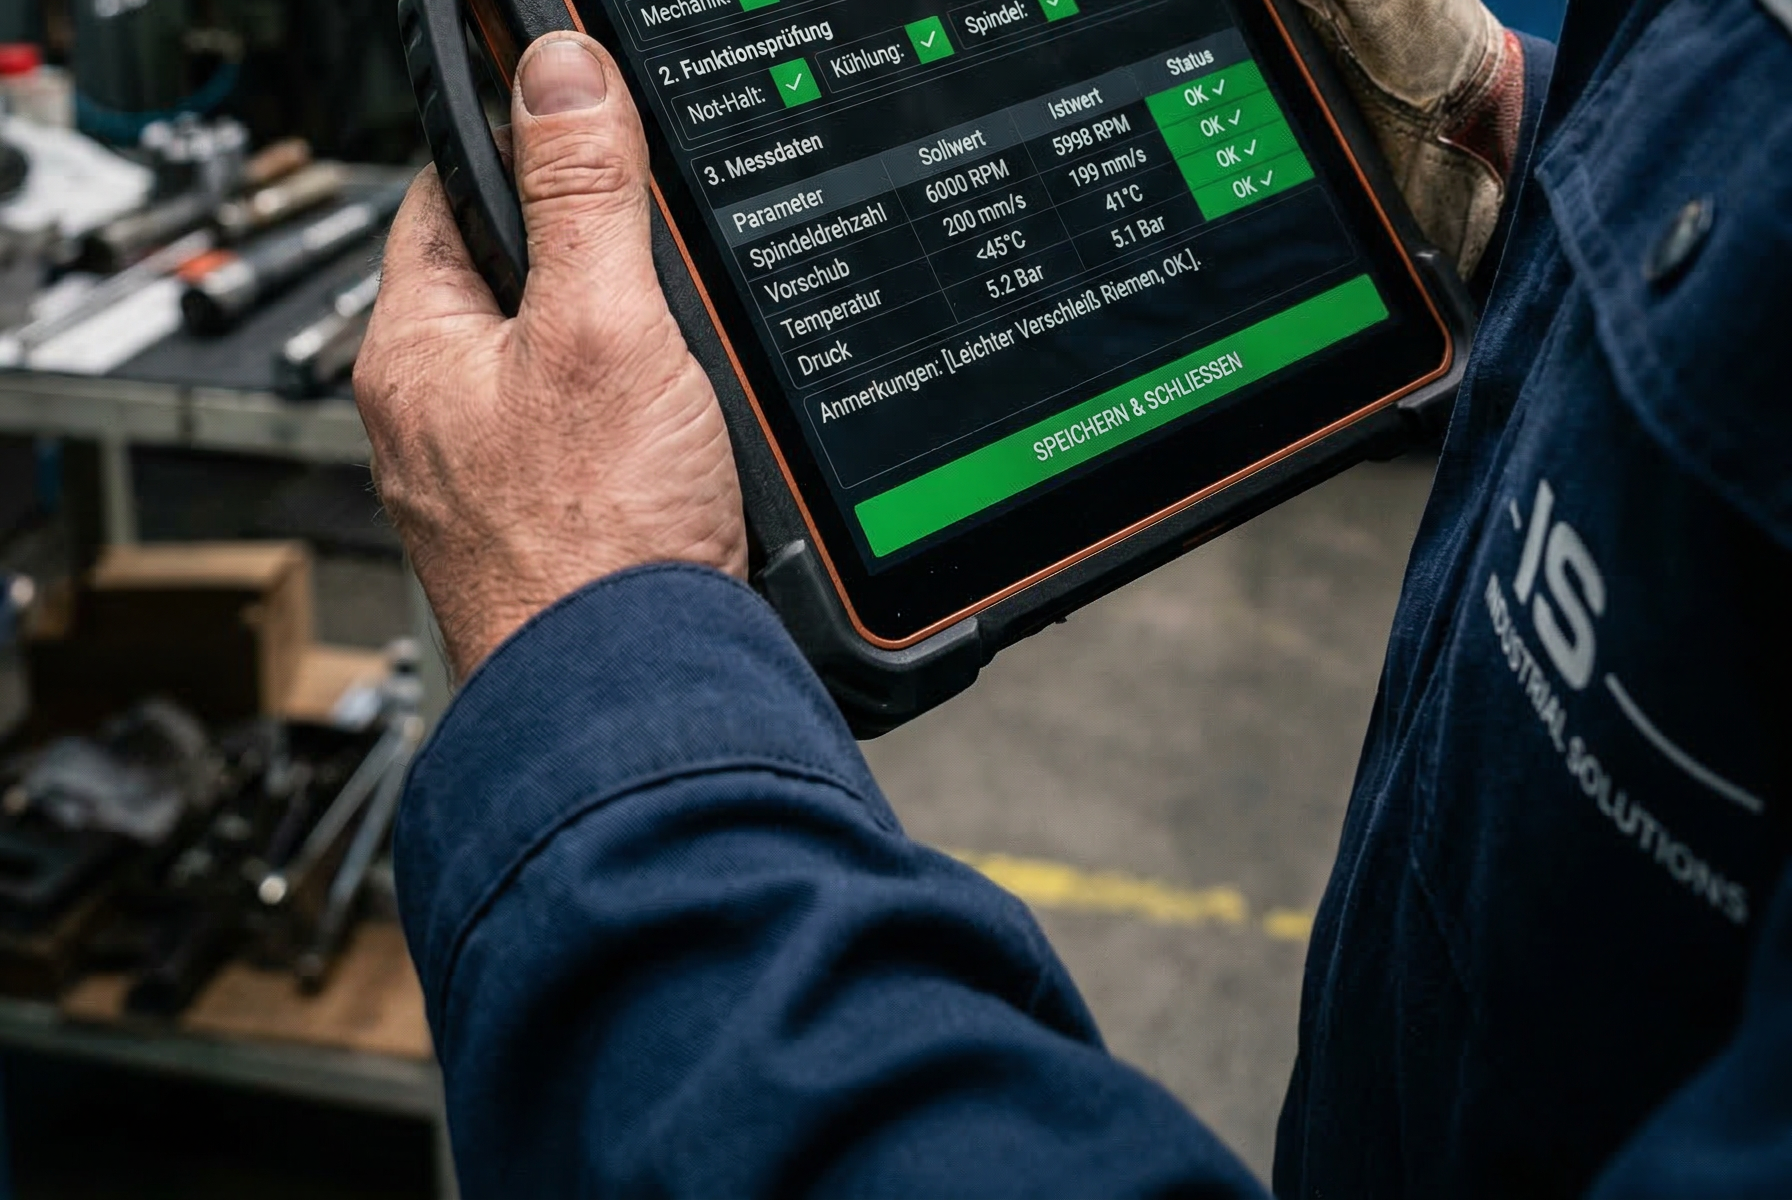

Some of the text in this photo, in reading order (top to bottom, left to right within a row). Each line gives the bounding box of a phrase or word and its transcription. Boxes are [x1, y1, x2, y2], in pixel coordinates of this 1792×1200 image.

[658, 20, 834, 86] 2. Funktionsprüfung
[830, 43, 905, 78] Kühlung:
[965, 1, 1028, 36] Spindel:
[687, 85, 766, 125] Not-Halt:
[703, 134, 823, 186] 3. Messdaten
[732, 49, 1215, 233] Parameter Sollwert Istwert Status
[749, 86, 1210, 270] Spindeldrehzahl 6000 RPM 5998 RPM OK
[764, 116, 1225, 303] Vorschub 200 mm/s 199 mm/s OK
[780, 147, 1241, 340] Temperatur <45°C 41°C OK
[797, 178, 1258, 377] Druck 5.2 Bar 5.1 Bar OK
[819, 358, 945, 424] Anmerkungen:
[945, 329, 1016, 374] [Leichter
[1014, 289, 1101, 339] Verschleiß
[1099, 268, 1165, 304] Riemen,
[1033, 350, 1244, 463] SPEICHERN & SCHLIESSEN
[1566, 735, 1749, 925] SOLUTIONS
